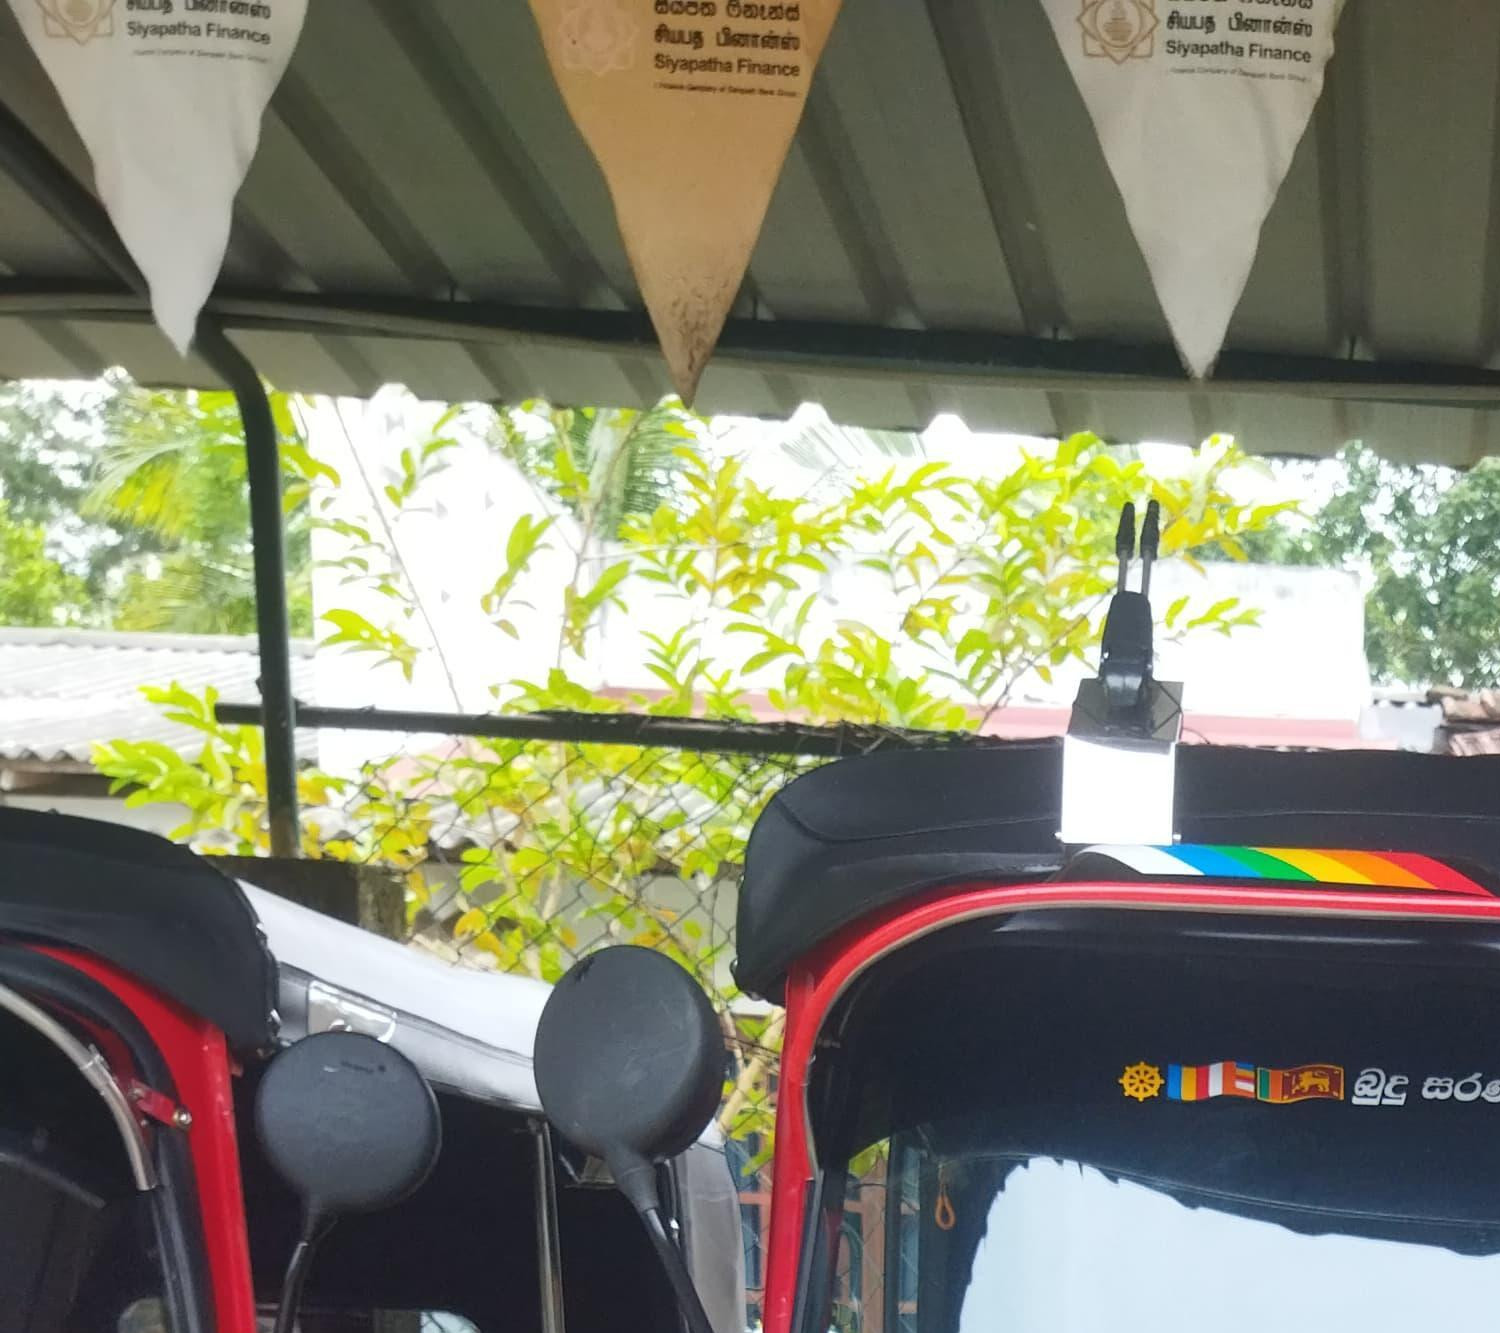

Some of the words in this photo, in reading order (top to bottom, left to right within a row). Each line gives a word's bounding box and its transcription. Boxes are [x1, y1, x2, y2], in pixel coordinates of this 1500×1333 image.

[127, 21, 201, 38] Siyapatha
[206, 23, 270, 44] Finance
[1166, 40, 1244, 57] Siyapatha
[1249, 43, 1312, 63] Finance
[655, 53, 732, 74] Siyapatha
[737, 58, 800, 77] Finance
[1352, 1068, 1409, 1106] බුදු
